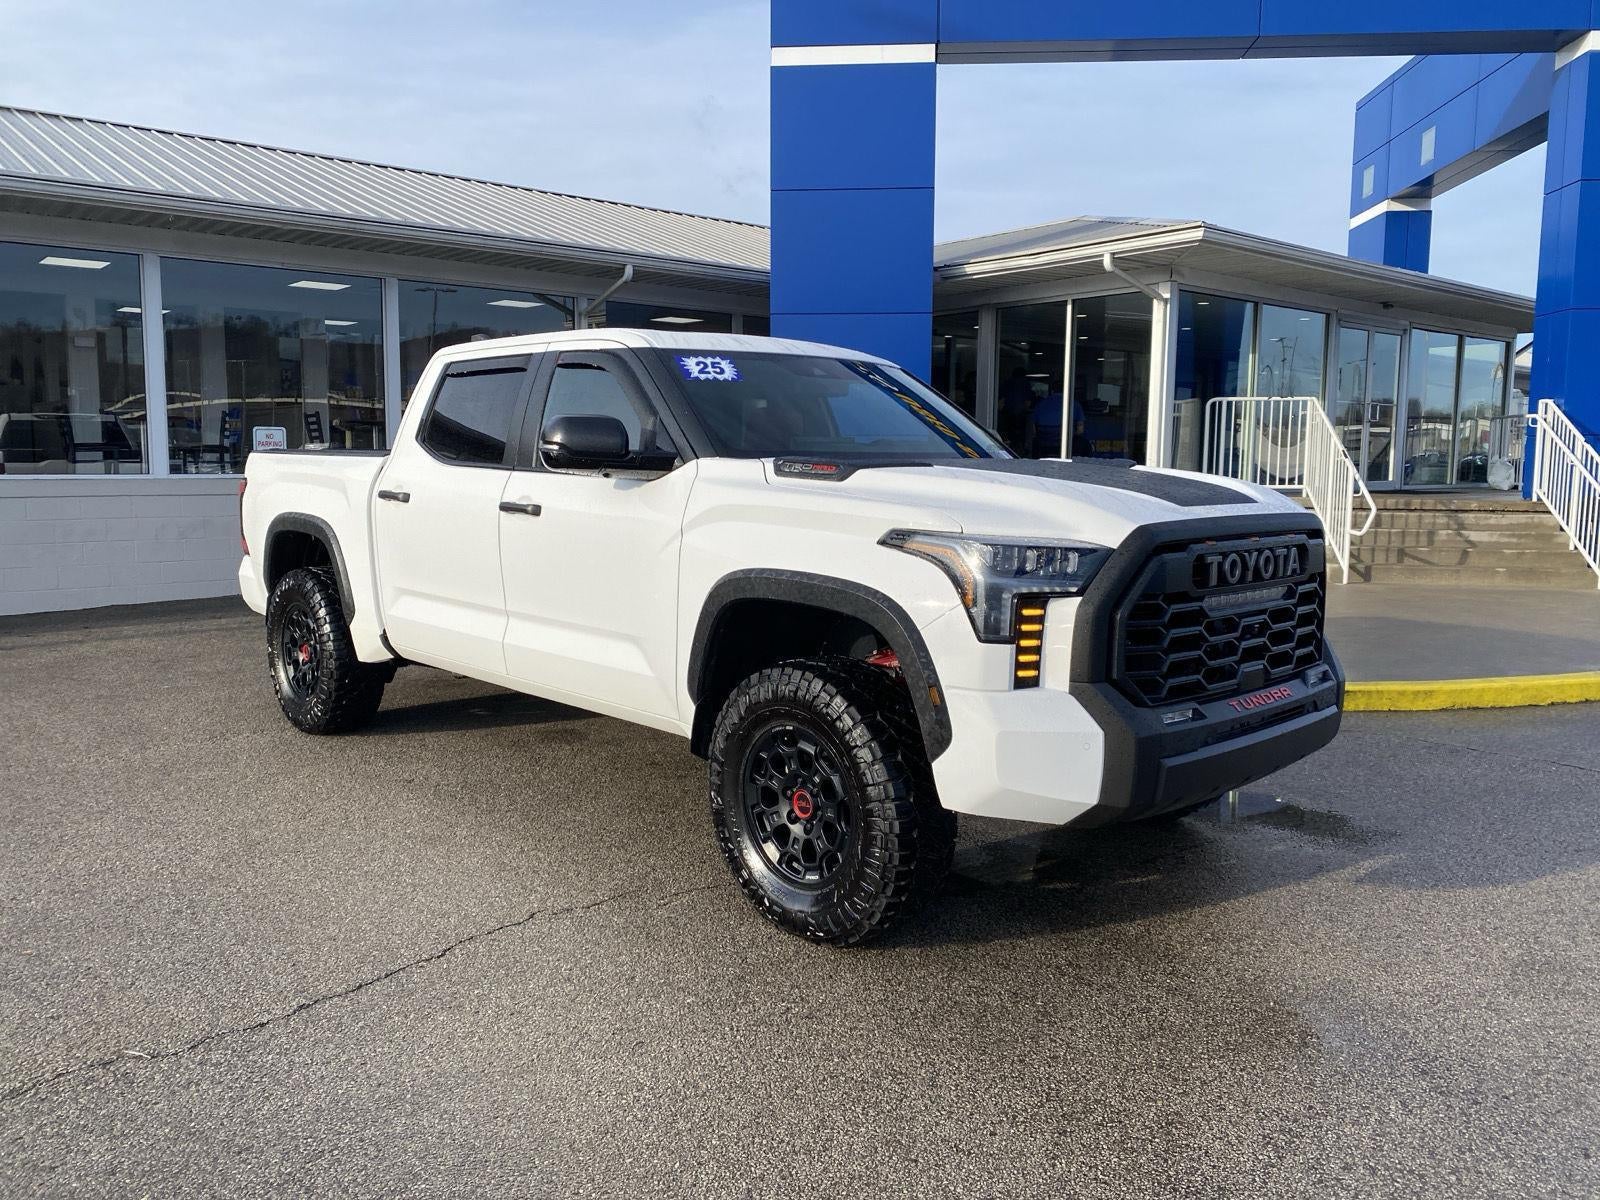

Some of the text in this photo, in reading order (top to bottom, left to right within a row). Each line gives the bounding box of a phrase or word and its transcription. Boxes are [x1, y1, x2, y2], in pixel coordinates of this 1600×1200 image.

[695, 360, 725, 375] 25
[257, 440, 283, 448] PARKING
[1207, 547, 1300, 587] TOYOTA
[1228, 686, 1294, 712] TUNDRA
